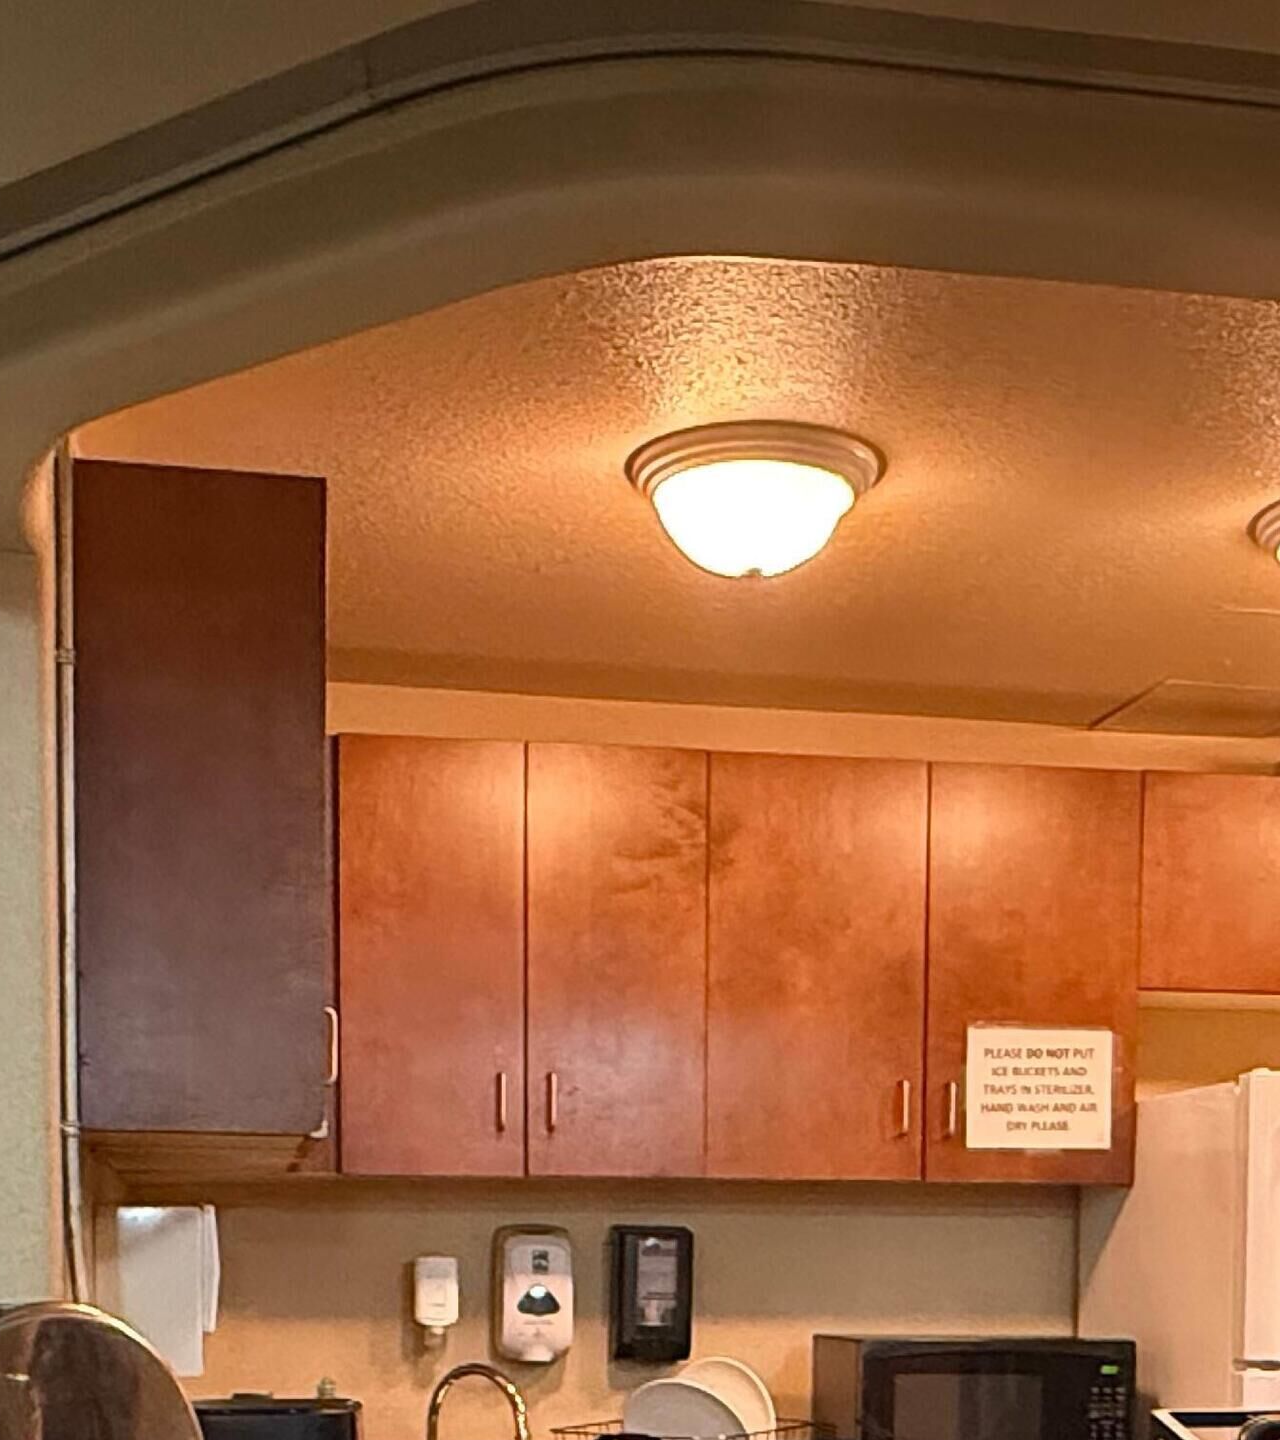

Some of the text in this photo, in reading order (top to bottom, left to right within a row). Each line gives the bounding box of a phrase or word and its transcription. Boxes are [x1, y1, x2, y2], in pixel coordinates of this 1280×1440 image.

[983, 1048, 1095, 1059] PLEASE DO NOT PUT
[991, 1067, 1088, 1076] ICE BUCKETS AND
[983, 1084, 1017, 1095] TRAYS
[1020, 1085, 1032, 1095] IN
[981, 1103, 1098, 1113] HAND WASH AND AIR
[1006, 1121, 1027, 1131] DRY
